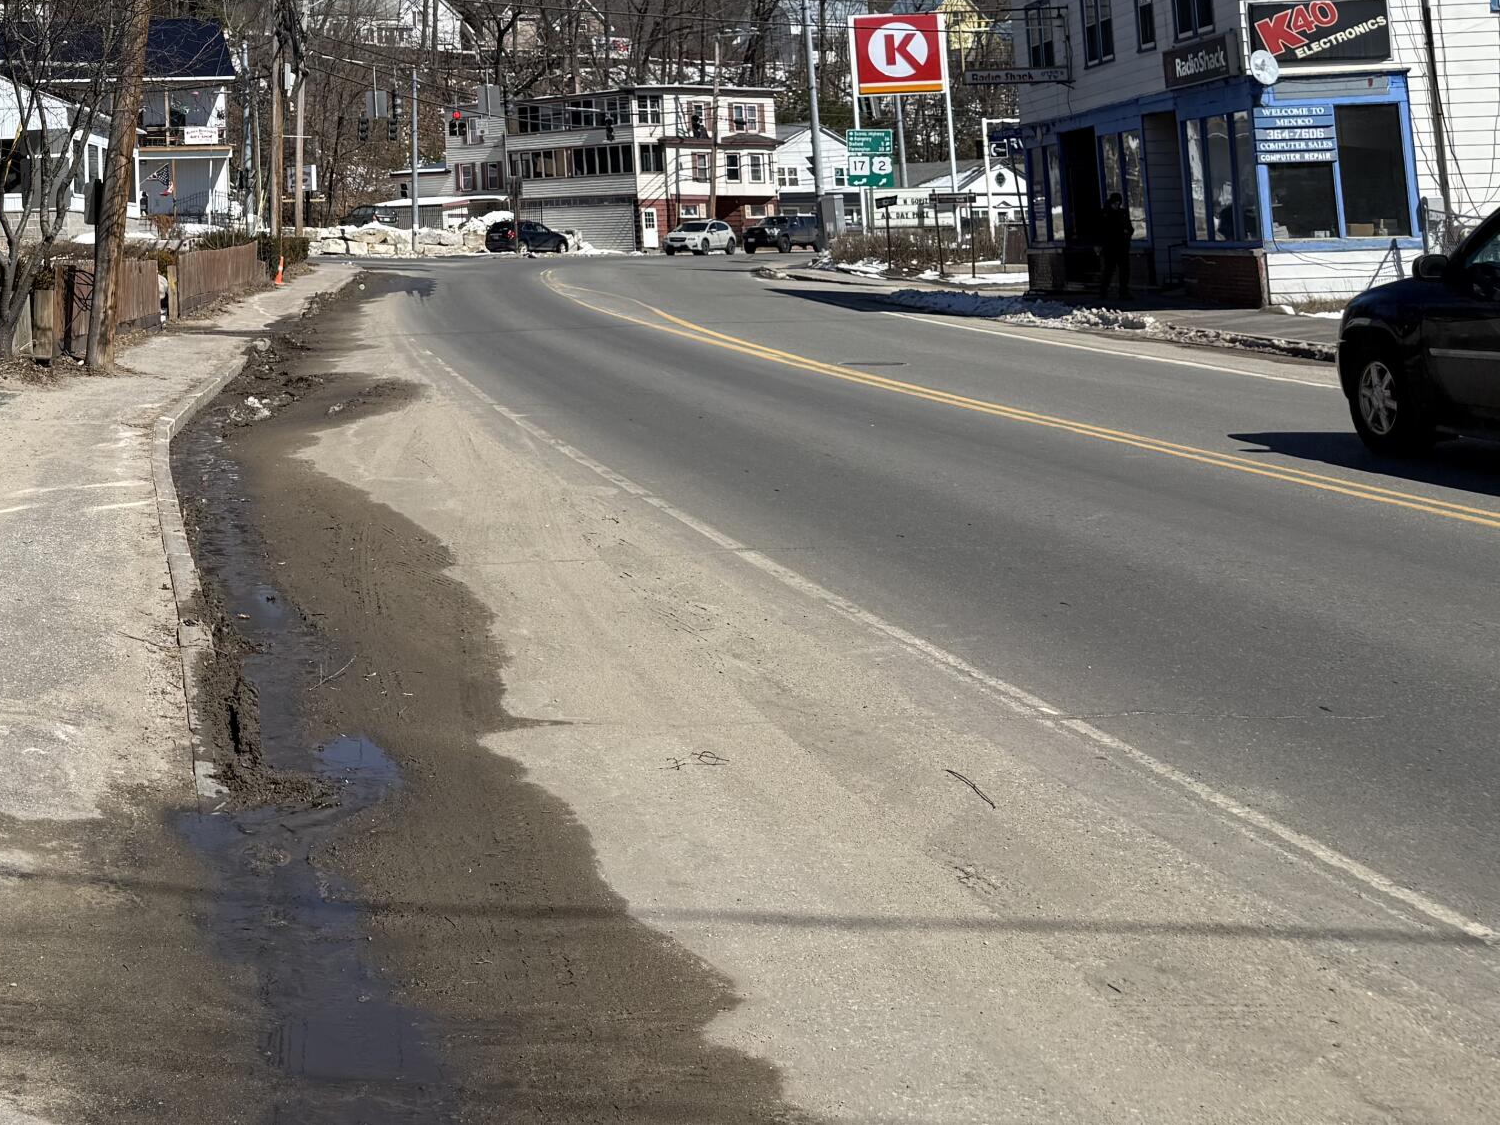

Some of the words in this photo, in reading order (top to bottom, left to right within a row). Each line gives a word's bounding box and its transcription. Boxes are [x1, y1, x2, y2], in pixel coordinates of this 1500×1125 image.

[1254, 0, 1338, 56] K40
[1294, 15, 1387, 59] ELECTRONICS
[884, 32, 925, 73] K
[1175, 45, 1226, 78] RadioShack
[1261, 107, 1308, 116] WELCOME
[1312, 107, 1325, 115] TO
[1275, 118, 1314, 127] MEXICO
[1266, 128, 1325, 139] 364-7606
[1260, 141, 1307, 150] COMPUTER
[1308, 140, 1333, 148] SALES
[1260, 153, 1300, 162] COMPUTER
[1304, 152, 1331, 161] REPAIR
[853, 160, 866, 172] 17
[878, 160, 887, 171] 2
